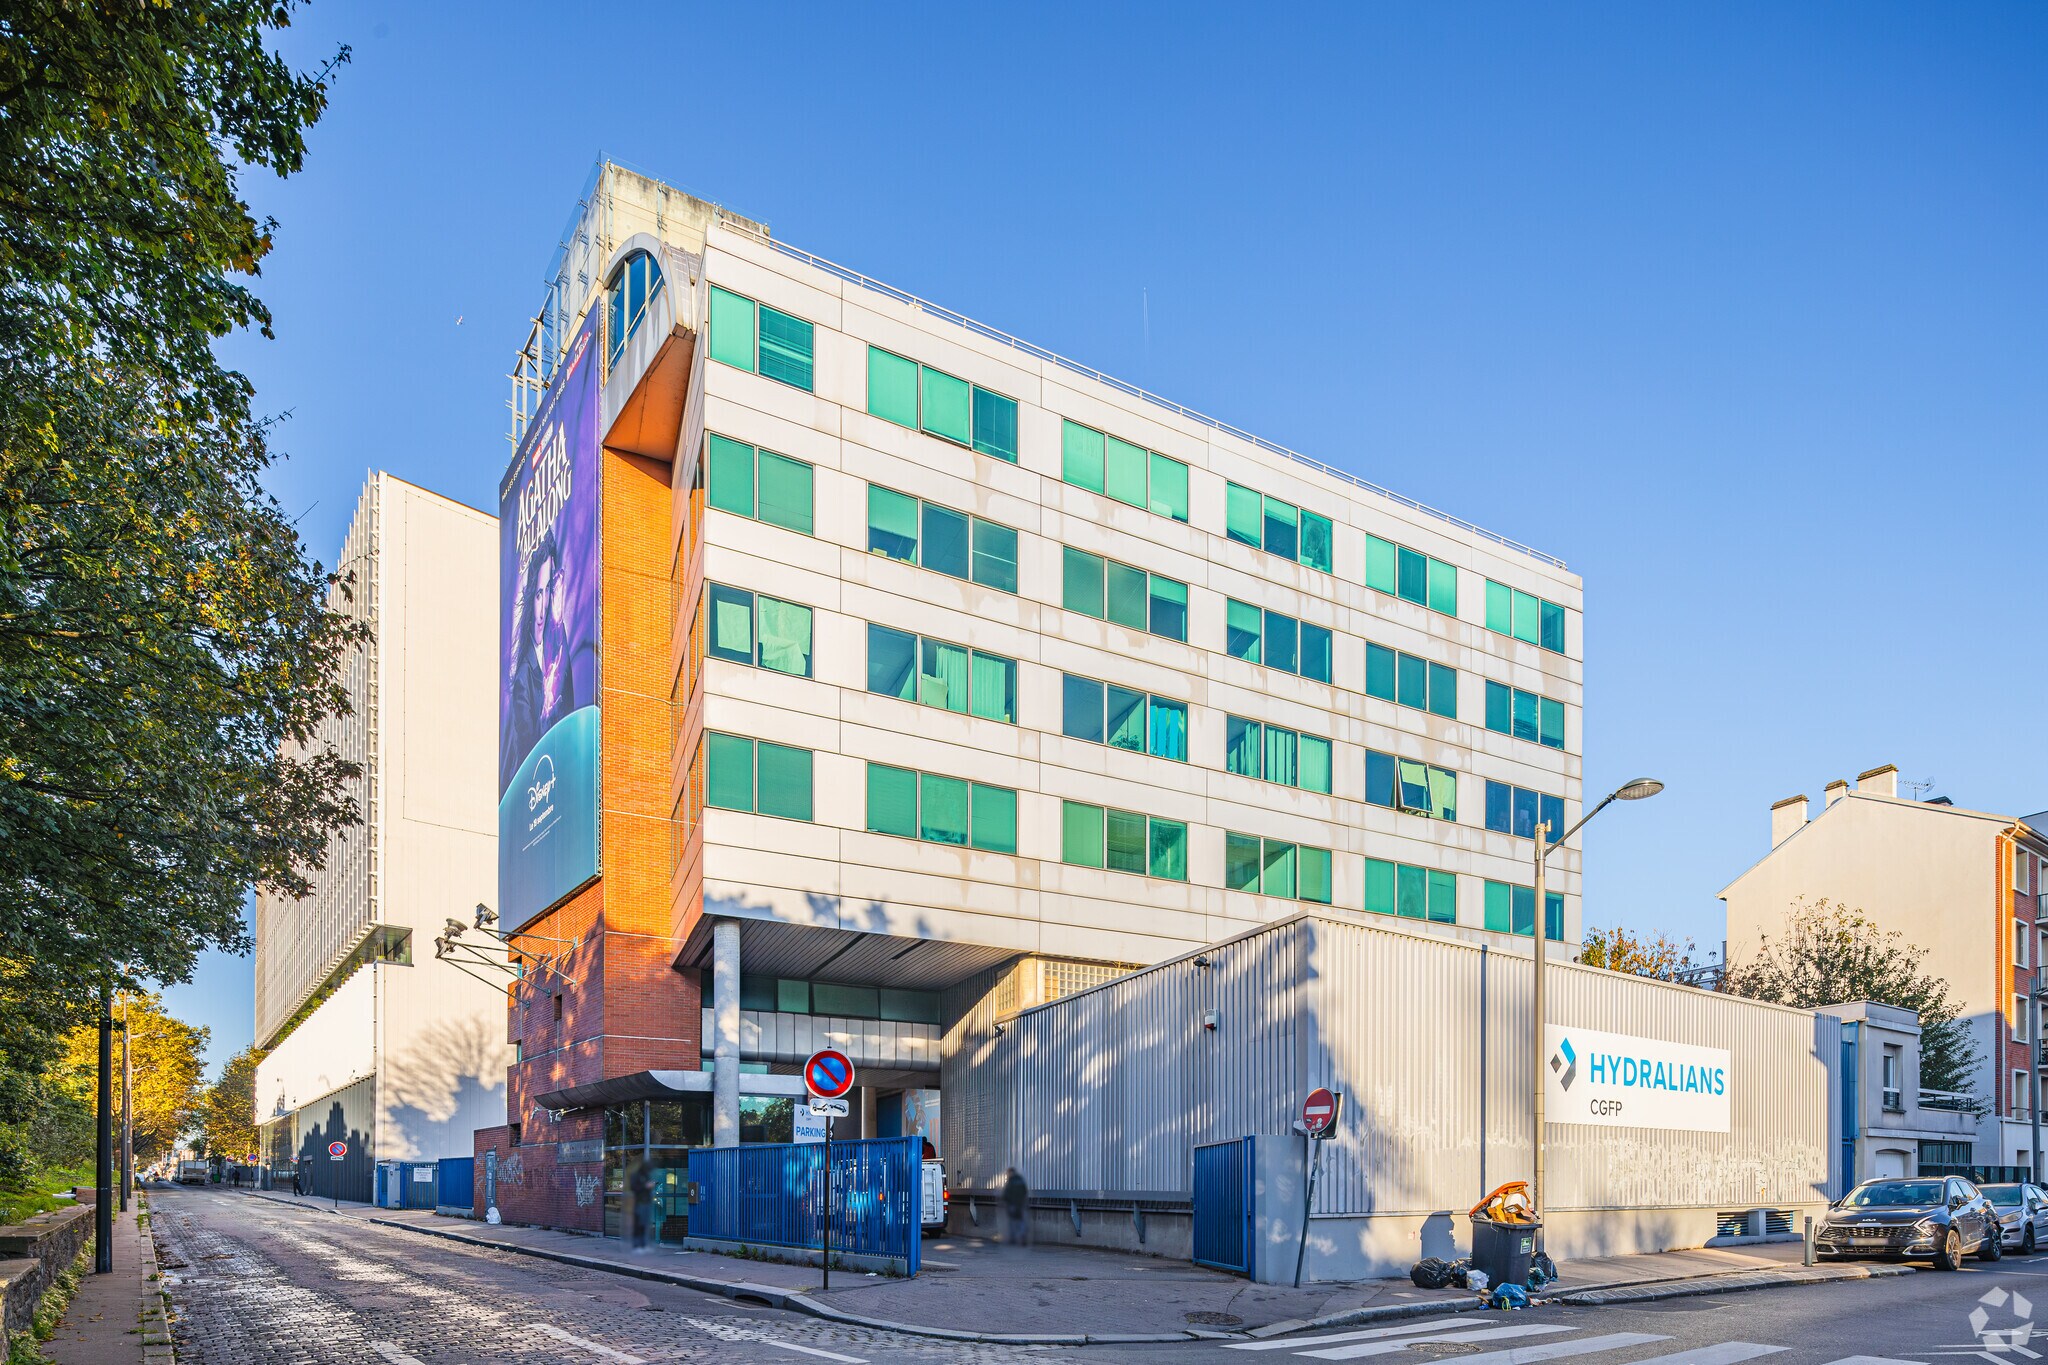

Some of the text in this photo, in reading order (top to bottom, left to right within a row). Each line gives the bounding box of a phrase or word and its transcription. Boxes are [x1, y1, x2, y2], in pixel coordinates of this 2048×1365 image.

[516, 421, 568, 554] AGATHA
[536, 458, 573, 551] ALONG
[1590, 1052, 1725, 1096] HYDRALIANS
[1590, 1098, 1623, 1117] CGFP
[796, 1126, 826, 1138] PARKING
